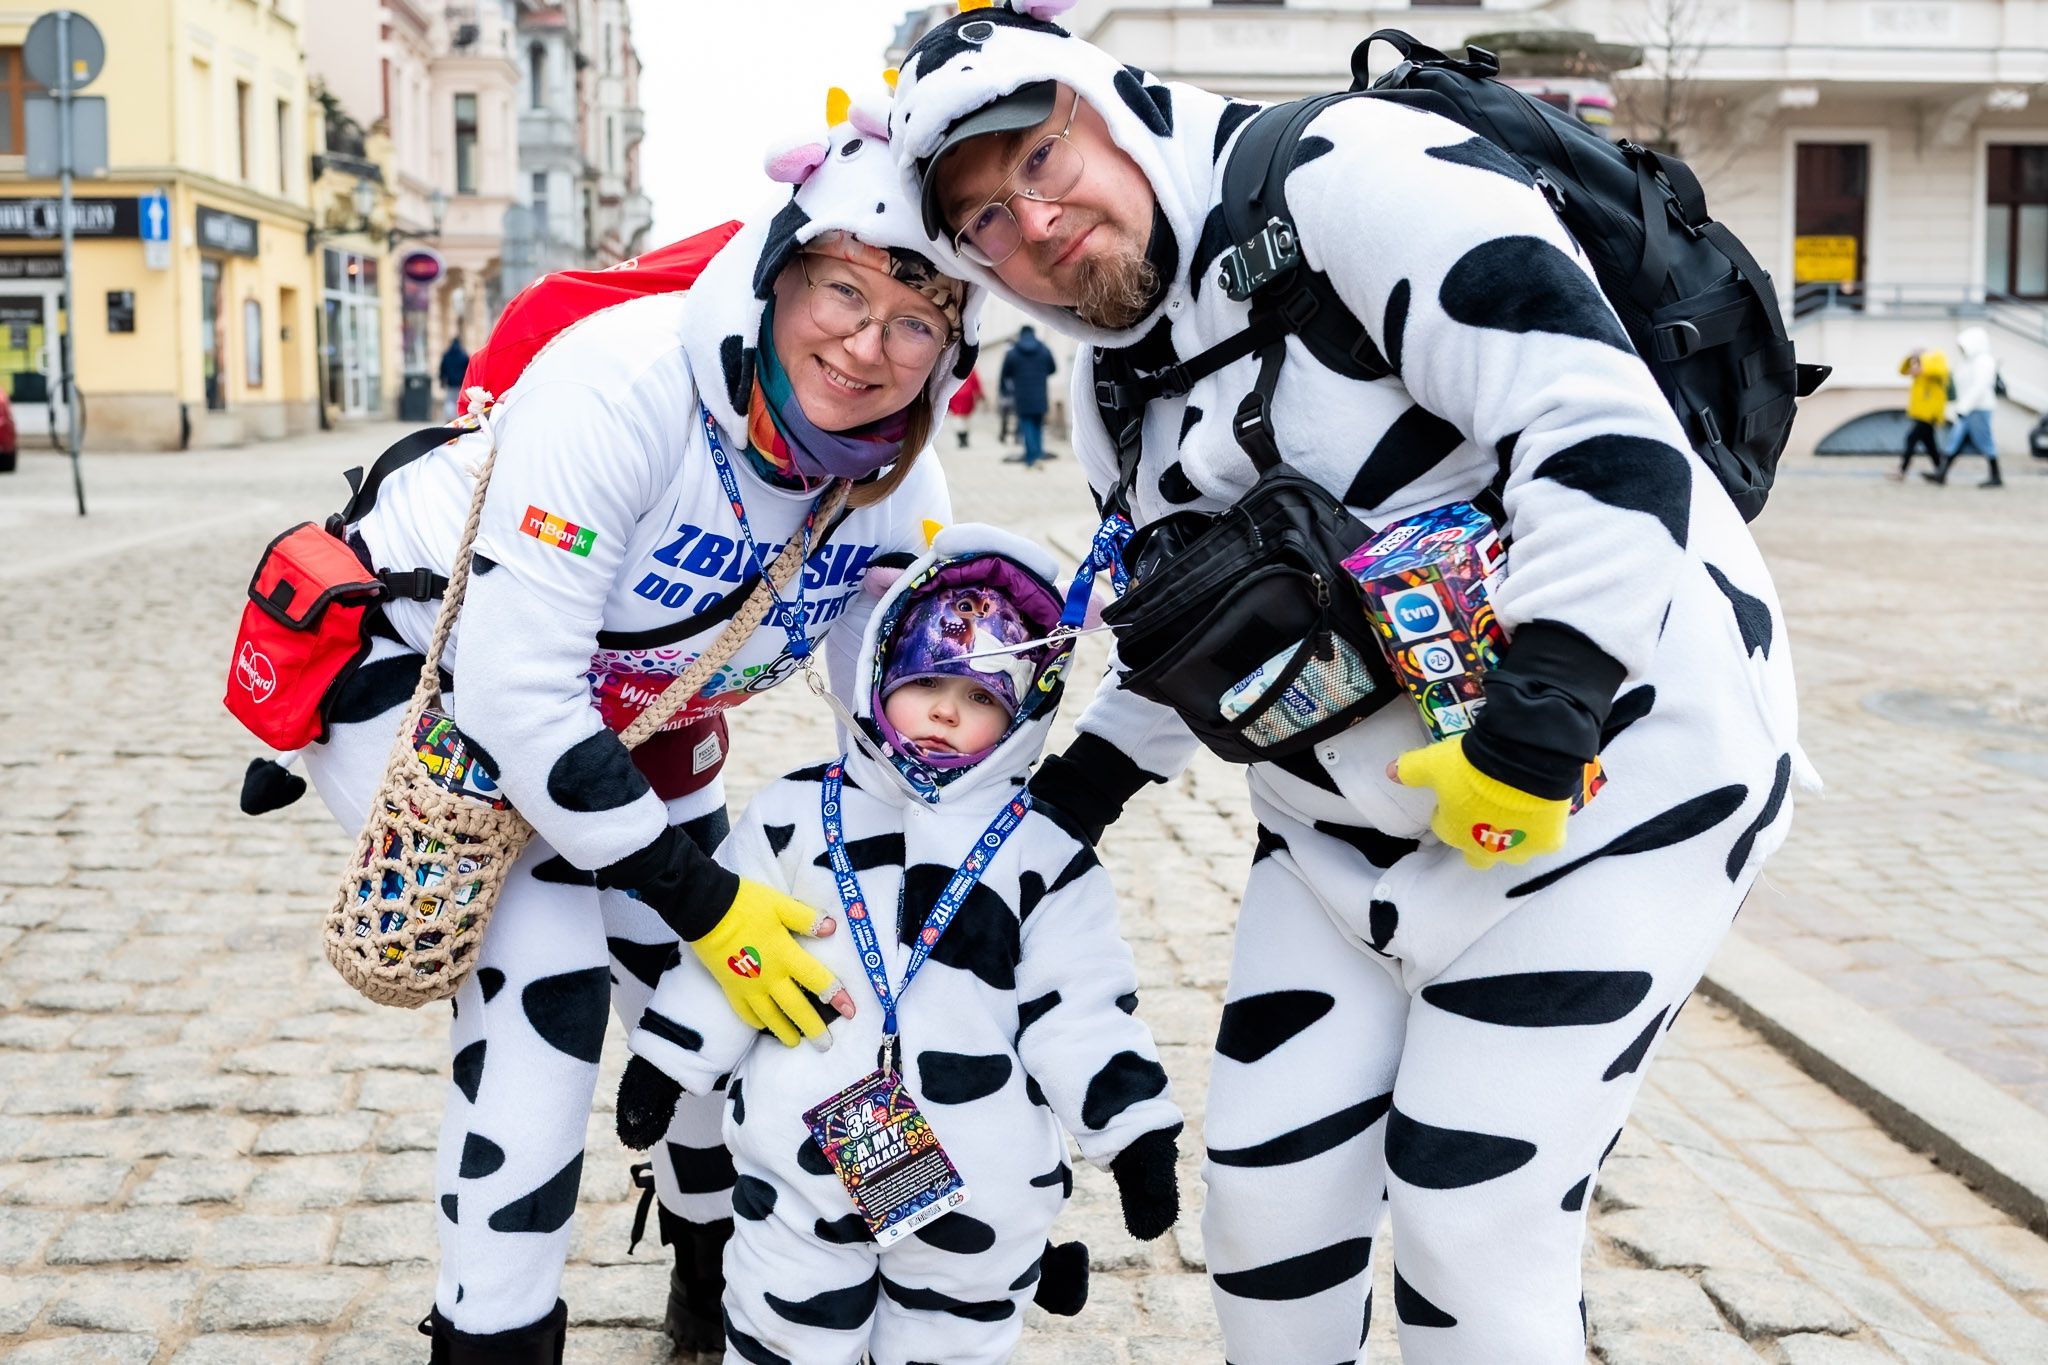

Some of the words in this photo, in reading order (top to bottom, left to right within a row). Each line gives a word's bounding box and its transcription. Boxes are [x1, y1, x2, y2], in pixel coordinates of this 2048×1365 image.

[530, 517, 587, 549] mBank
[1099, 520, 1120, 539] 112
[633, 572, 694, 609] DO
[1400, 605, 1434, 622] tvn
[1480, 829, 1513, 846] m
[832, 852, 842, 873] POMOC
[836, 845, 849, 873] PIERWSZA
[973, 849, 985, 870] 34
[840, 878, 858, 900] 112
[948, 875, 965, 895] POMOC
[953, 876, 973, 902] PIERWSZA
[421, 903, 435, 915] ups
[932, 902, 953, 925] 112
[734, 954, 759, 974] m
[846, 1099, 876, 1139] 34
[857, 1142, 870, 1162] A
[872, 1123, 904, 1152] MY,
[860, 1139, 908, 1174] POLACY,
